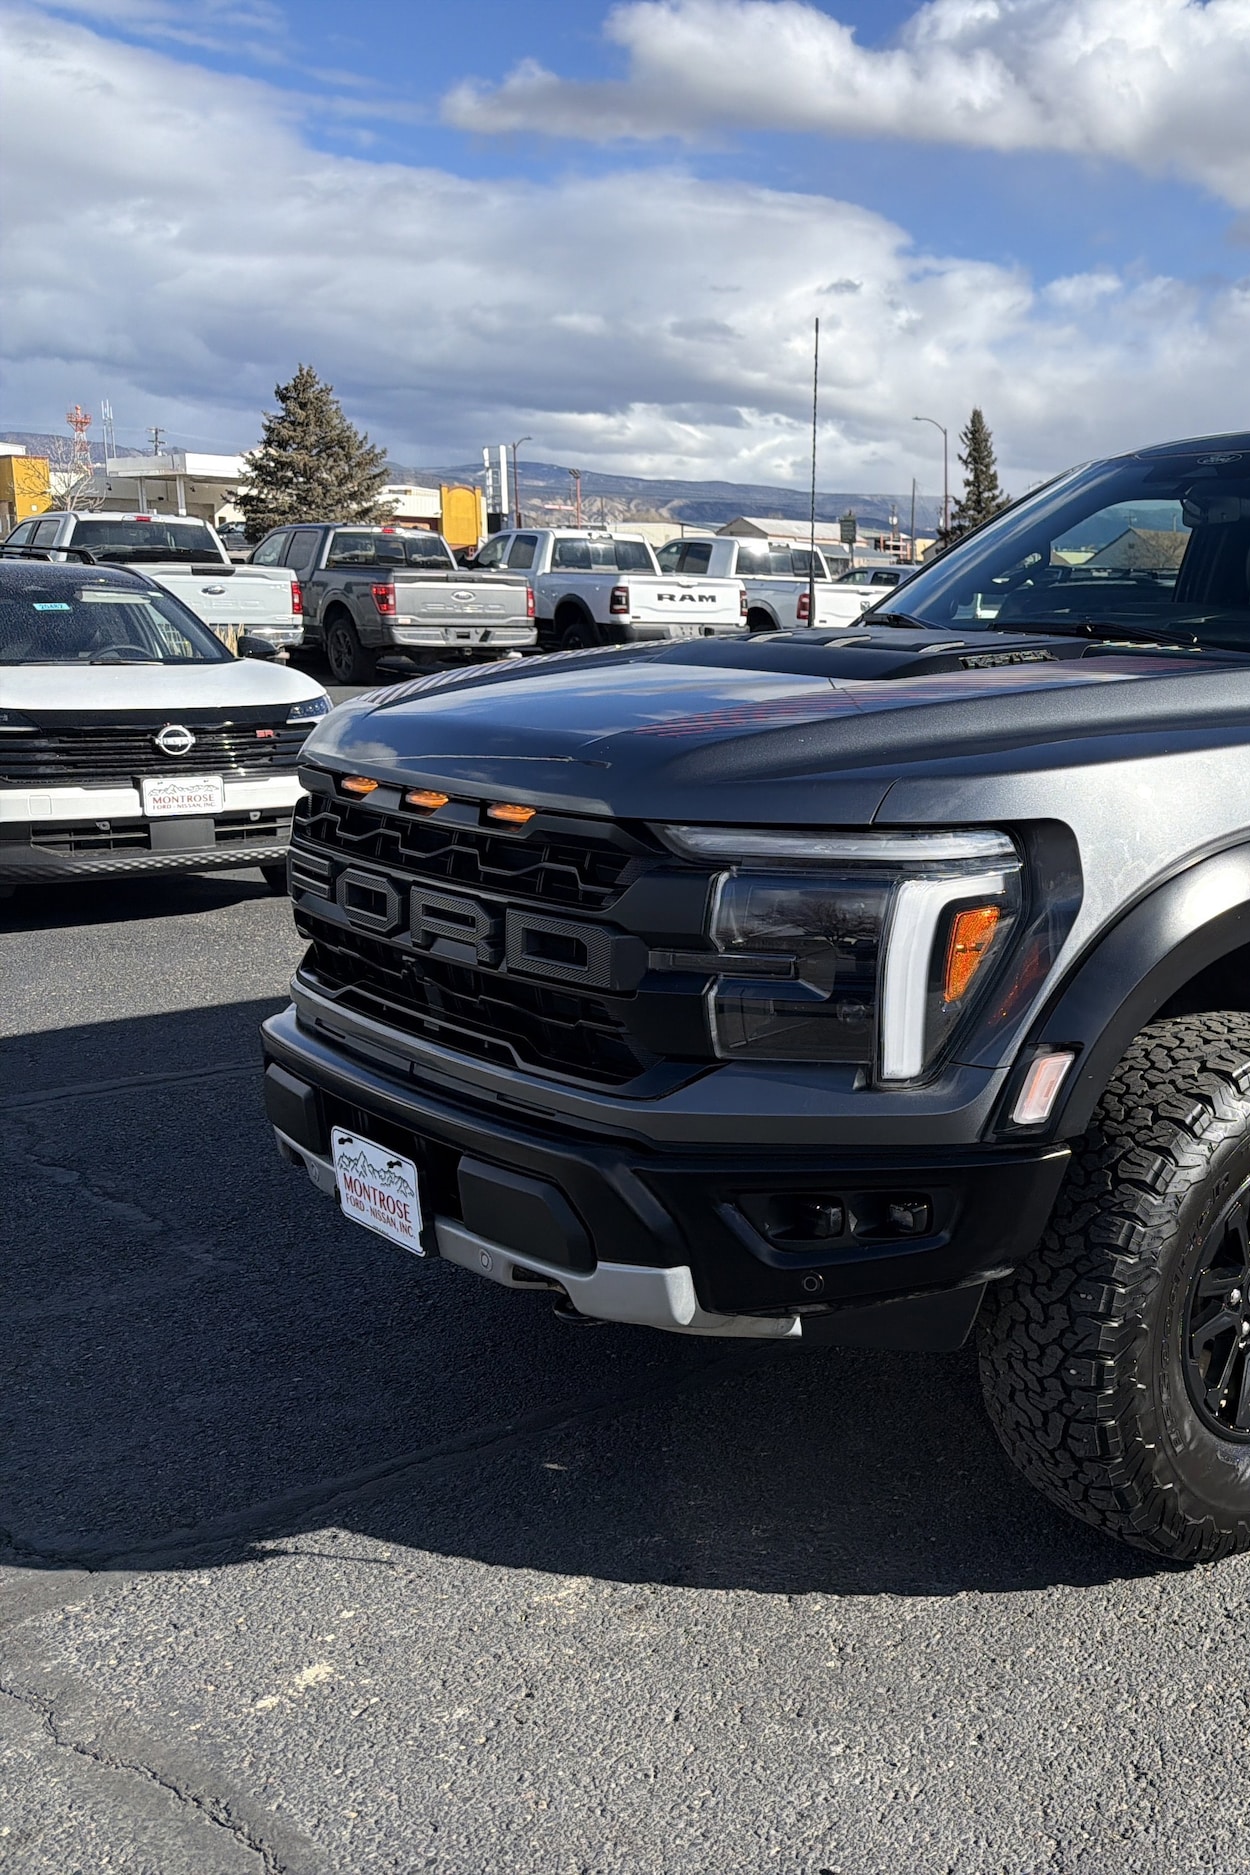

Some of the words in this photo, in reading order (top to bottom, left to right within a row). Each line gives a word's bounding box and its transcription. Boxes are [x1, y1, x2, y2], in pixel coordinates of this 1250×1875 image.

[656, 593, 716, 603] RAM
[152, 793, 214, 805] MONTROSE
[288, 847, 645, 991] FORD
[343, 1172, 412, 1224] MONTROSE
[345, 1193, 365, 1212] FORD
[399, 1221, 416, 1239] INC.
